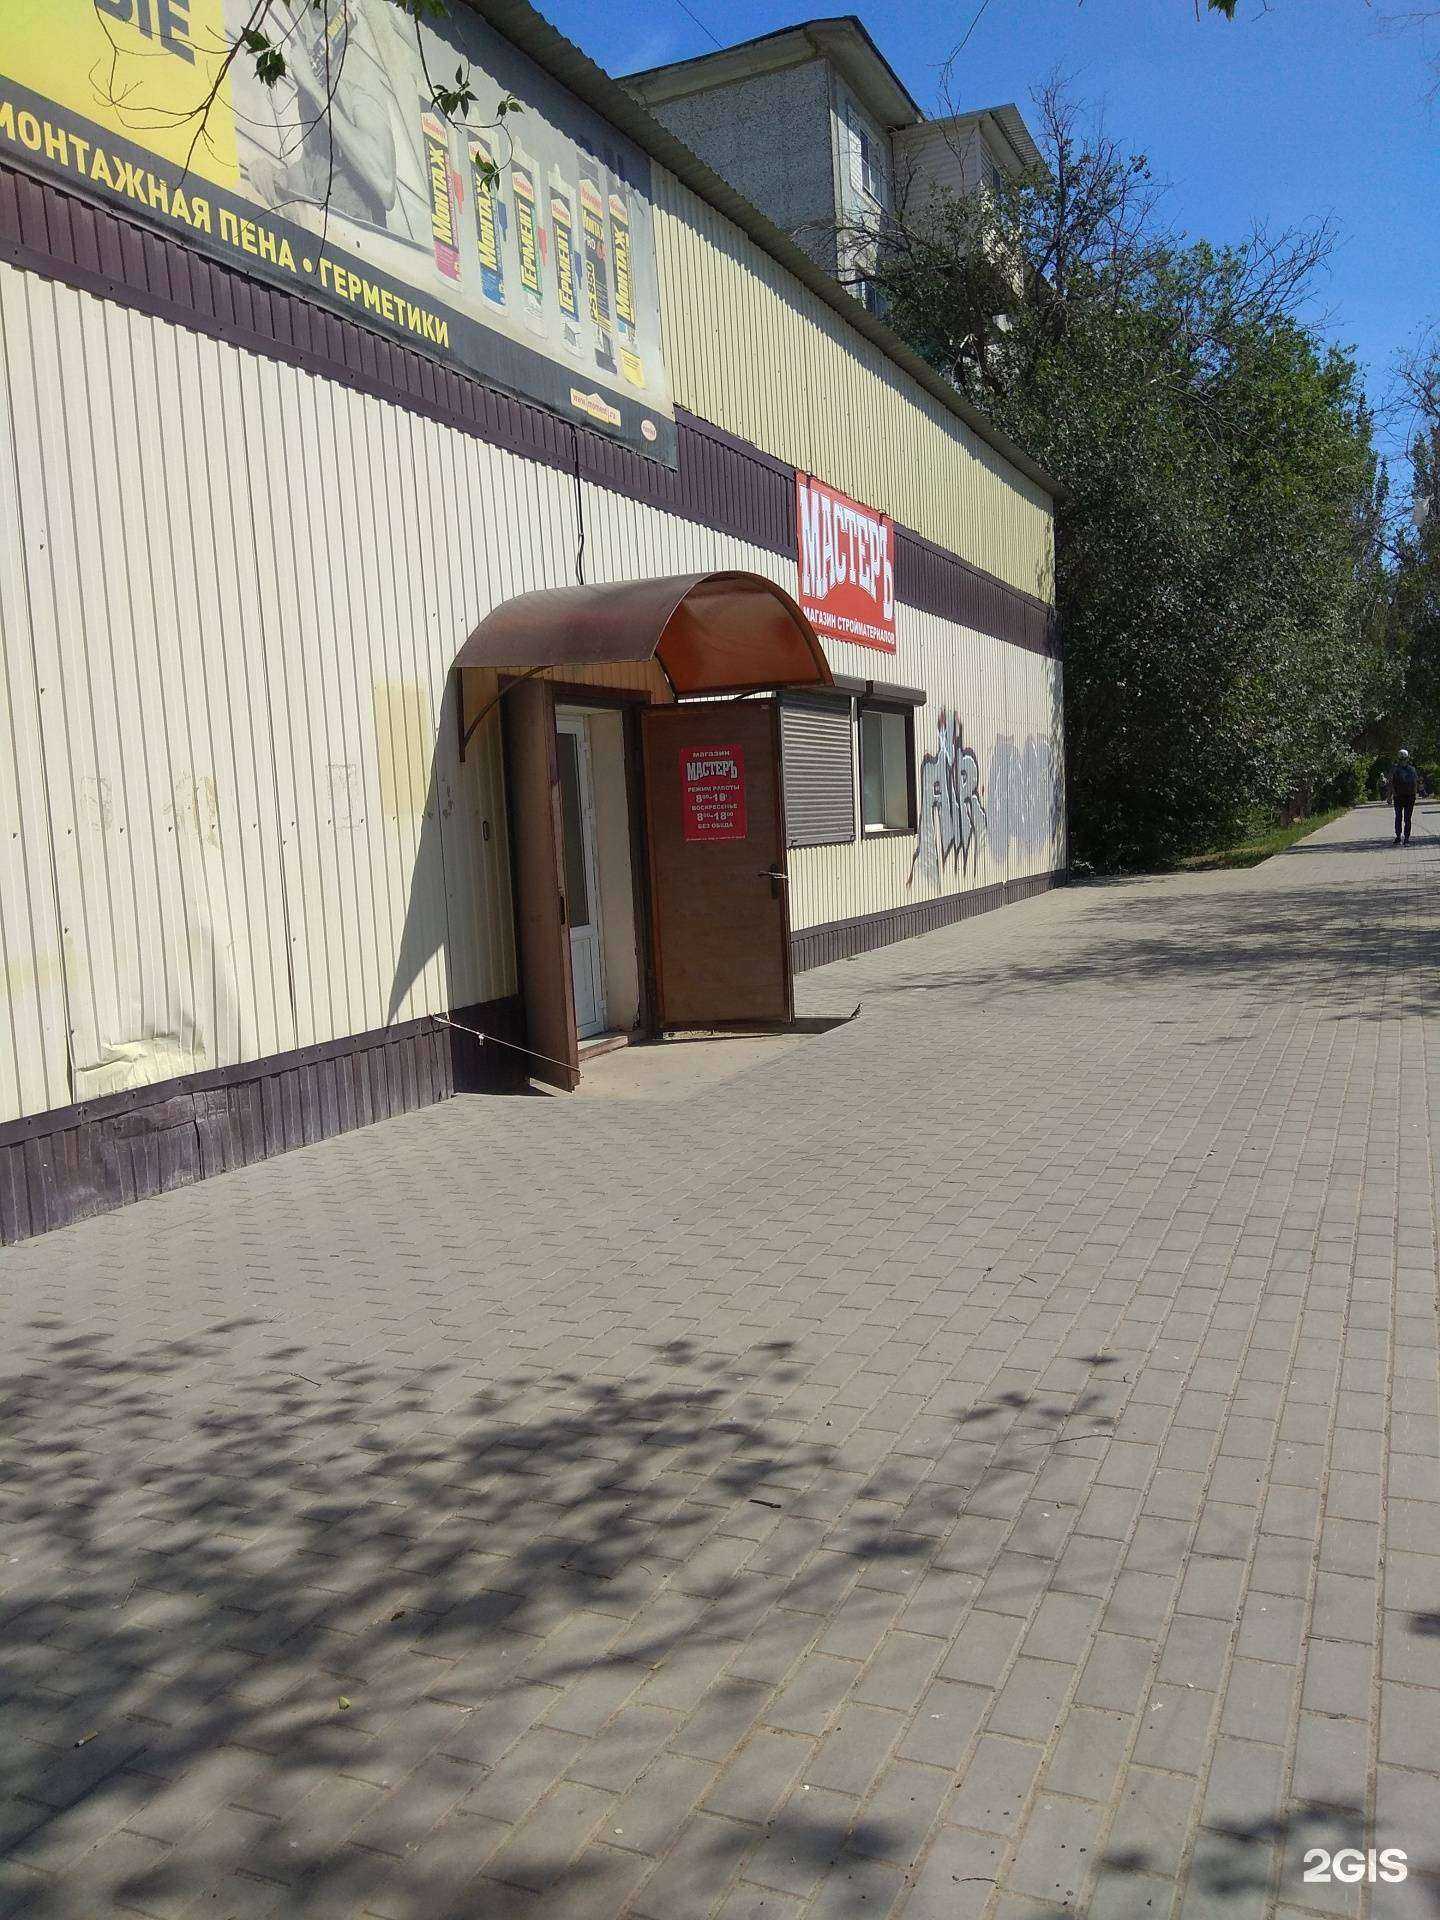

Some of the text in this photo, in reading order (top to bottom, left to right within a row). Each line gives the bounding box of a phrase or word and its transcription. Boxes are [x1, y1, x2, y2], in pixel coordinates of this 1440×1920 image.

[219, 207, 297, 274] ПЕНА
[319, 257, 450, 349] ГЕРМЕТИКИ
[799, 484, 893, 622] МАСТЕРЪ
[802, 606, 895, 645] МАГАЗИН СТРОЙМАТЕРИАЛОВ
[686, 760, 738, 781] МАСТЕРЪ
